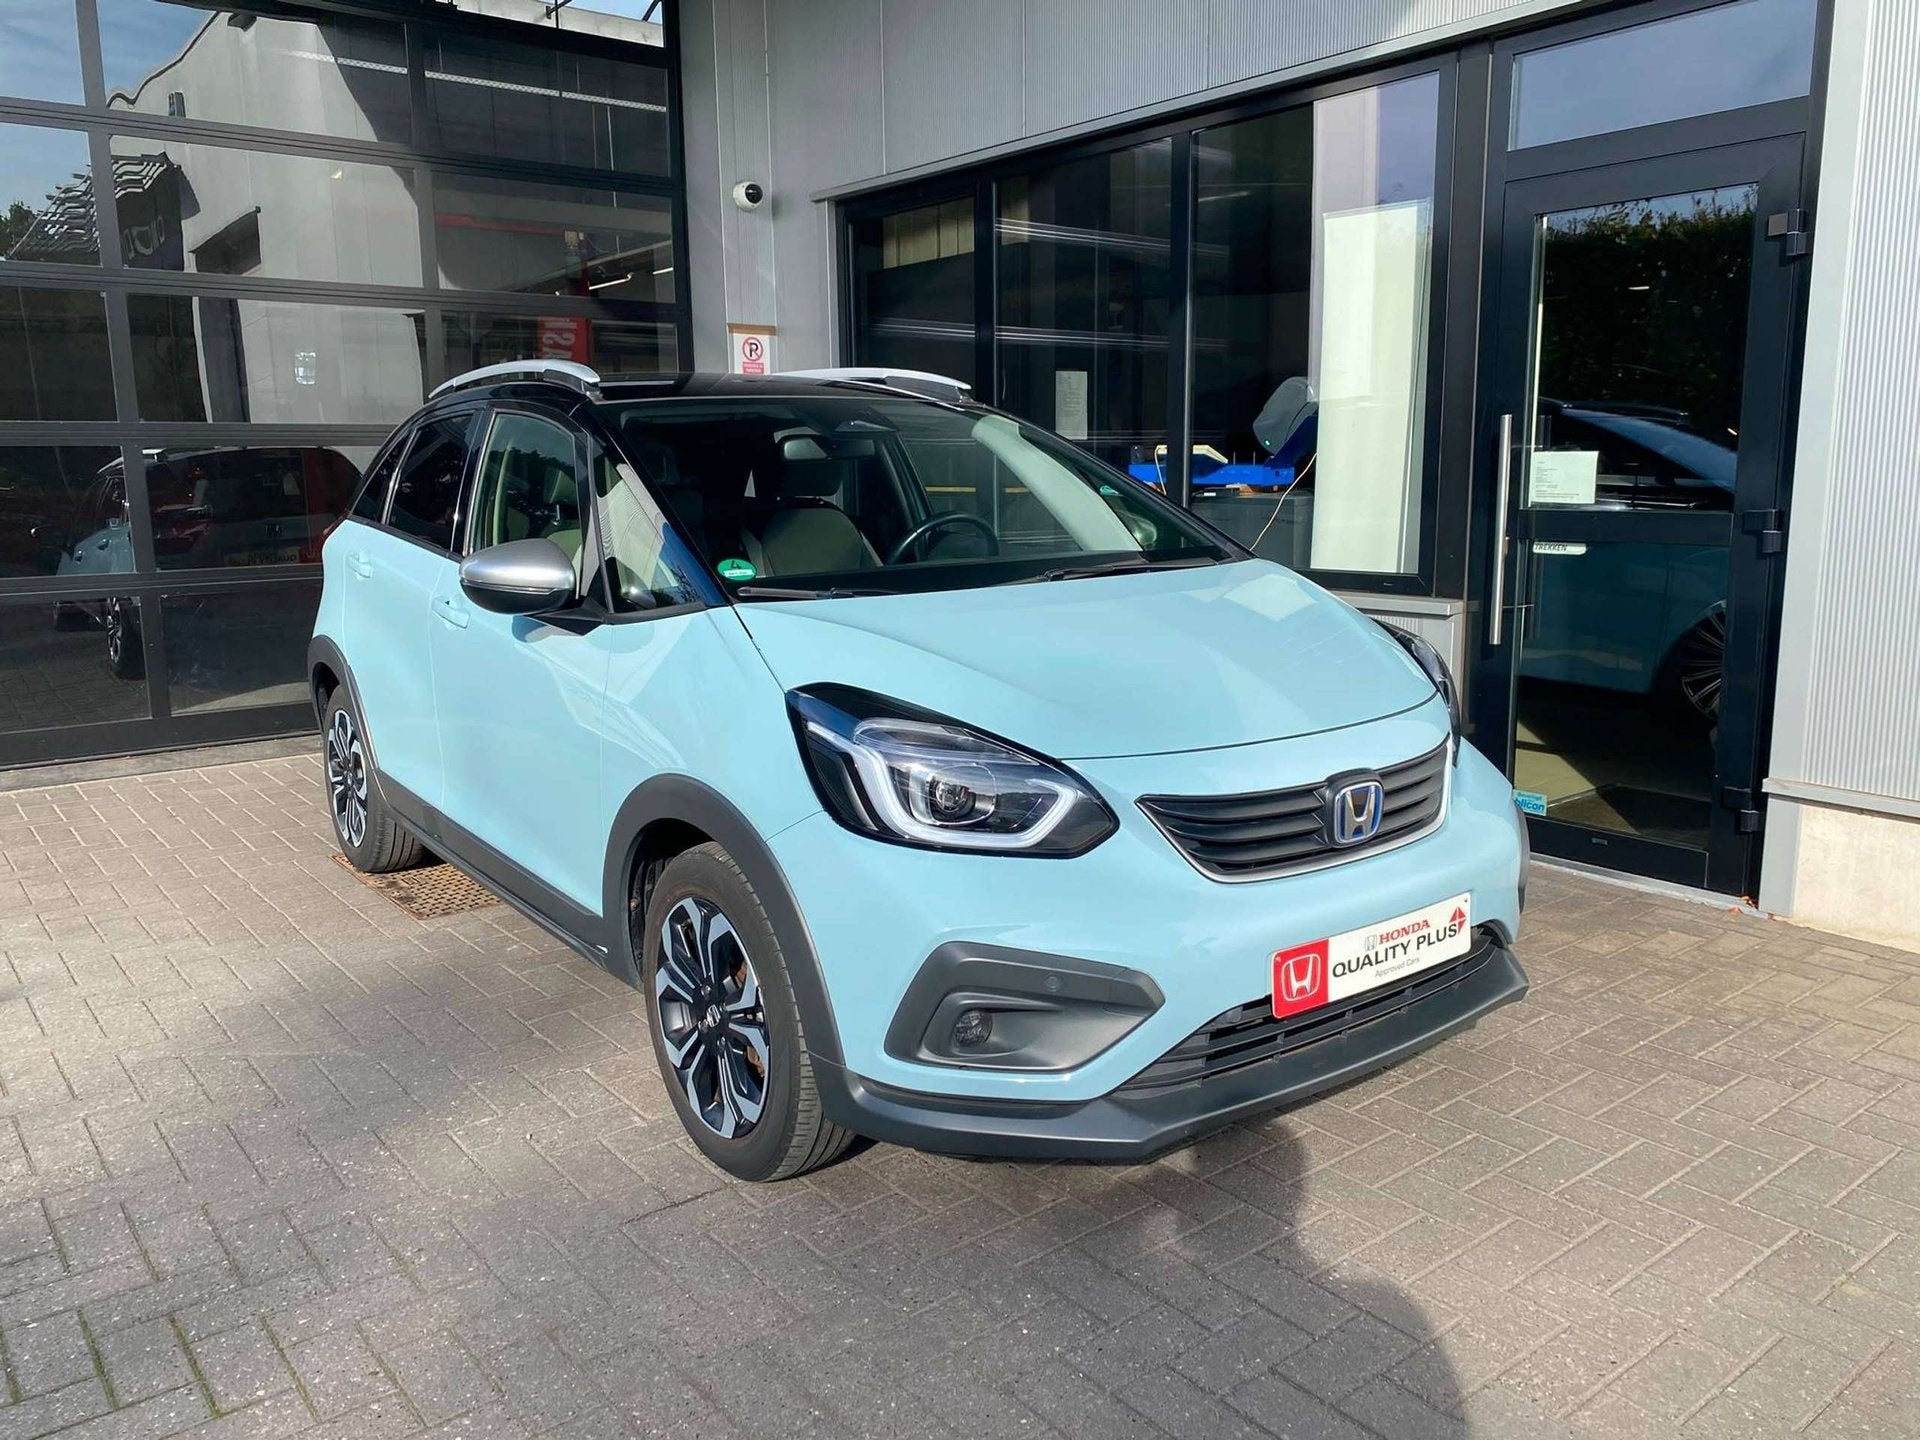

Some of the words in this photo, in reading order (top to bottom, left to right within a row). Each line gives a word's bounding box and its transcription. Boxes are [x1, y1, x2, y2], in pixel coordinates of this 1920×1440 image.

[1378, 919, 1431, 945] HONDA
[1332, 940, 1411, 978] QUALITY
[1416, 923, 1458, 950] PLUS
[1375, 961, 1405, 978] Approved
[1406, 957, 1420, 968] Cars
